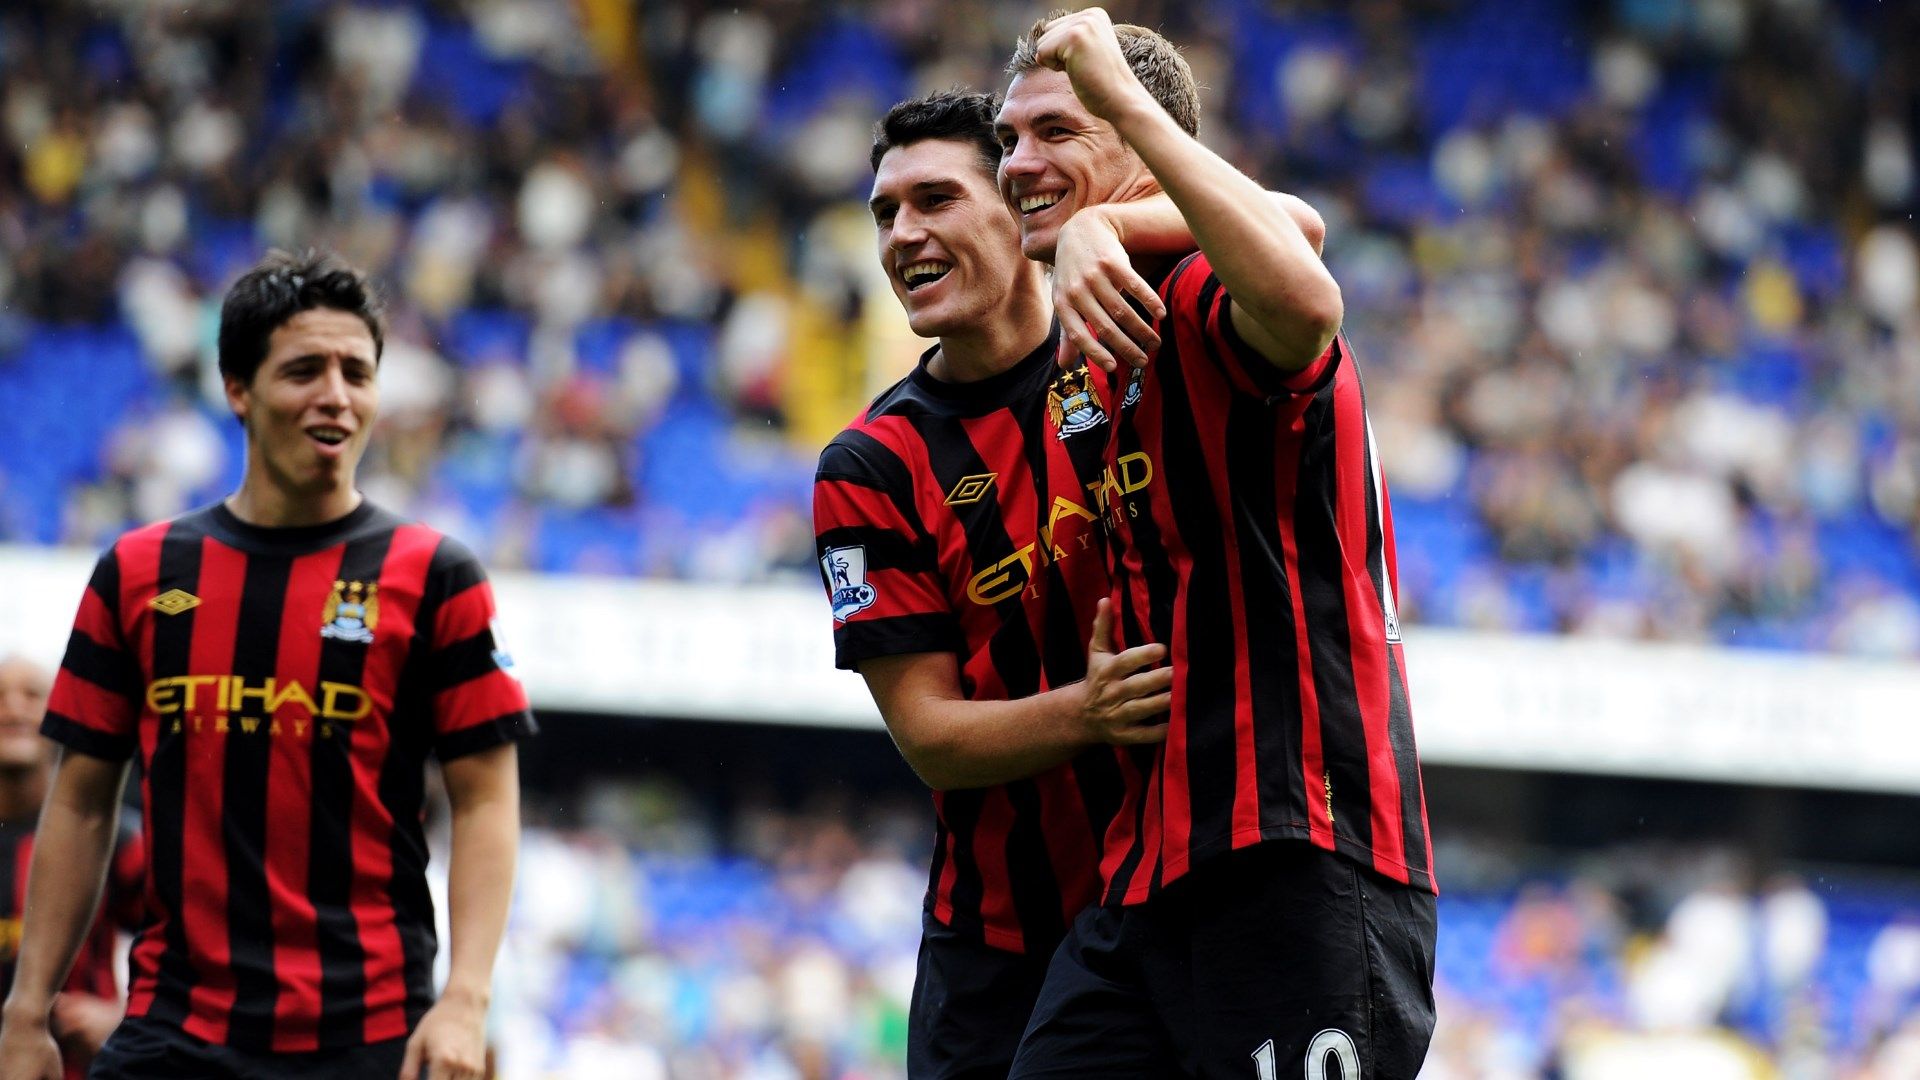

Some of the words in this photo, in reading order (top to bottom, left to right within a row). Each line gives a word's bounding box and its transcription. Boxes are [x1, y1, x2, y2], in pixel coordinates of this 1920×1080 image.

[146, 675, 372, 721] ETIHAD
[171, 716, 332, 738] AIRWAYS
[1250, 1028, 1361, 1080] 10
